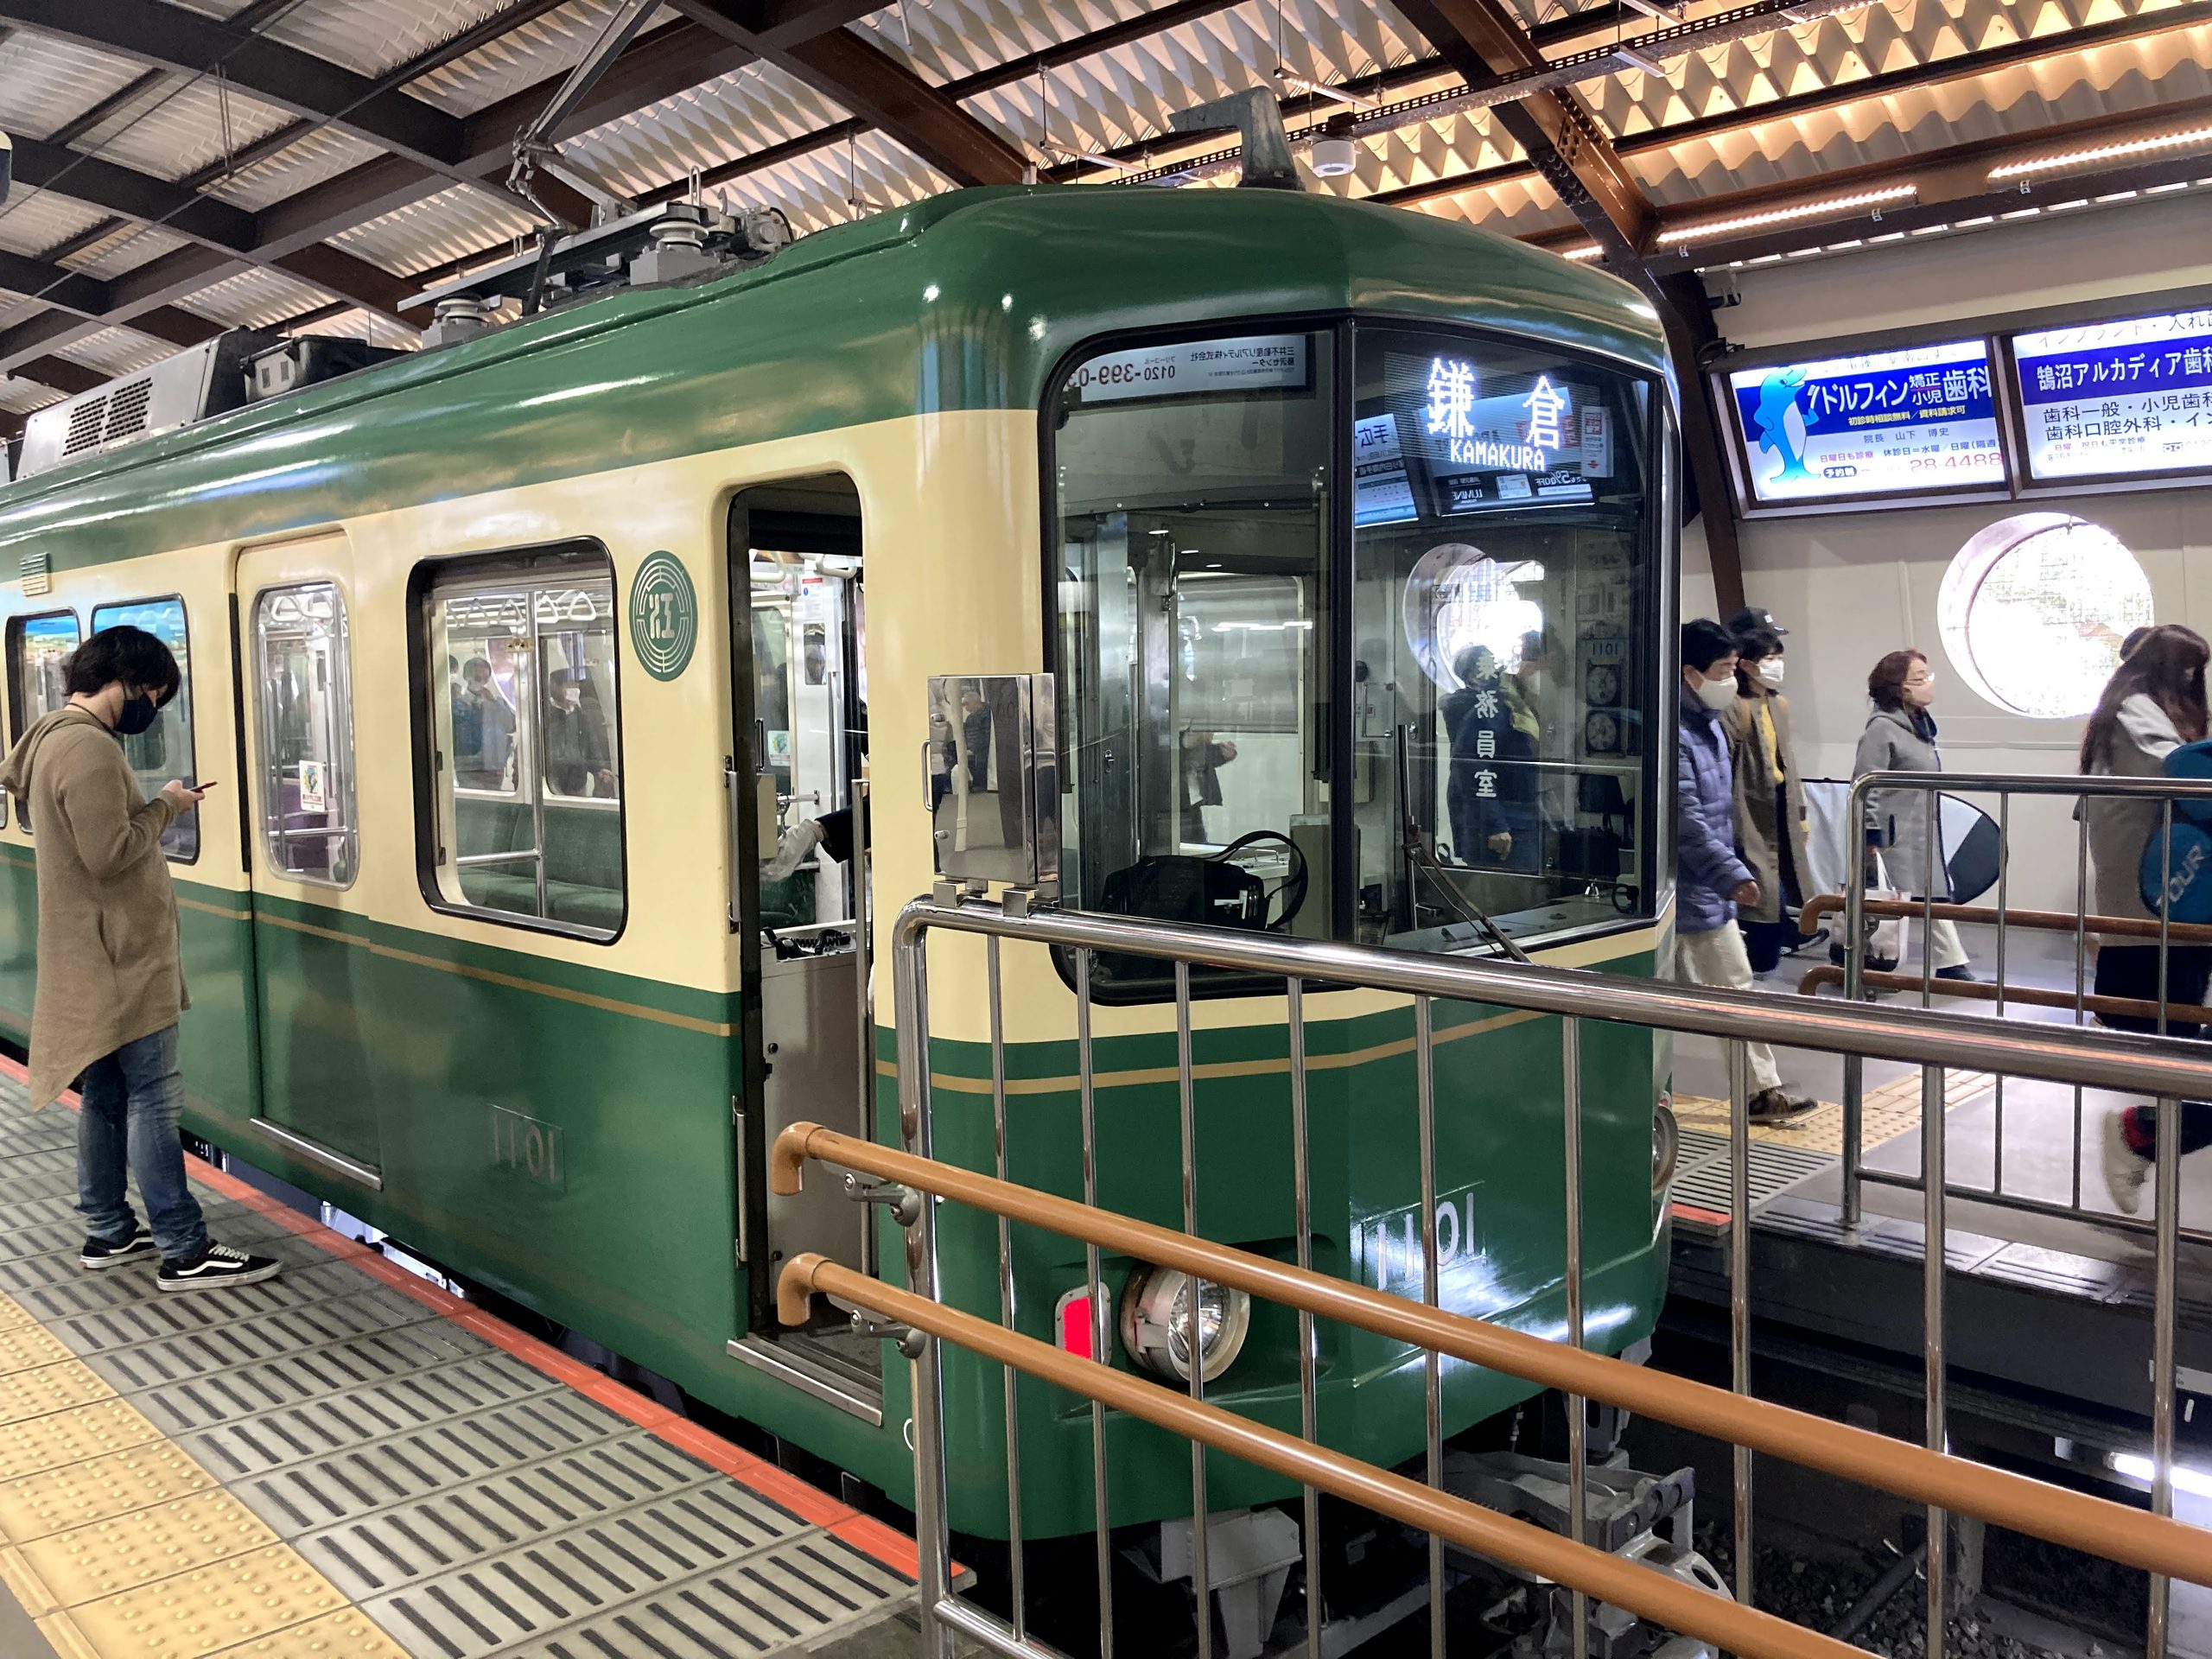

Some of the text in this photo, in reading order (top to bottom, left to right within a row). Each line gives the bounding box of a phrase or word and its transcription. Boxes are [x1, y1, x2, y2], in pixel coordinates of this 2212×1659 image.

[1450, 437, 1545, 472] KAMAKURA
[1895, 428, 1916, 442] 山下
[2156, 843, 2207, 906] OUR
[491, 1112, 556, 1182] 1101
[1376, 1192, 1476, 1291] 1101
